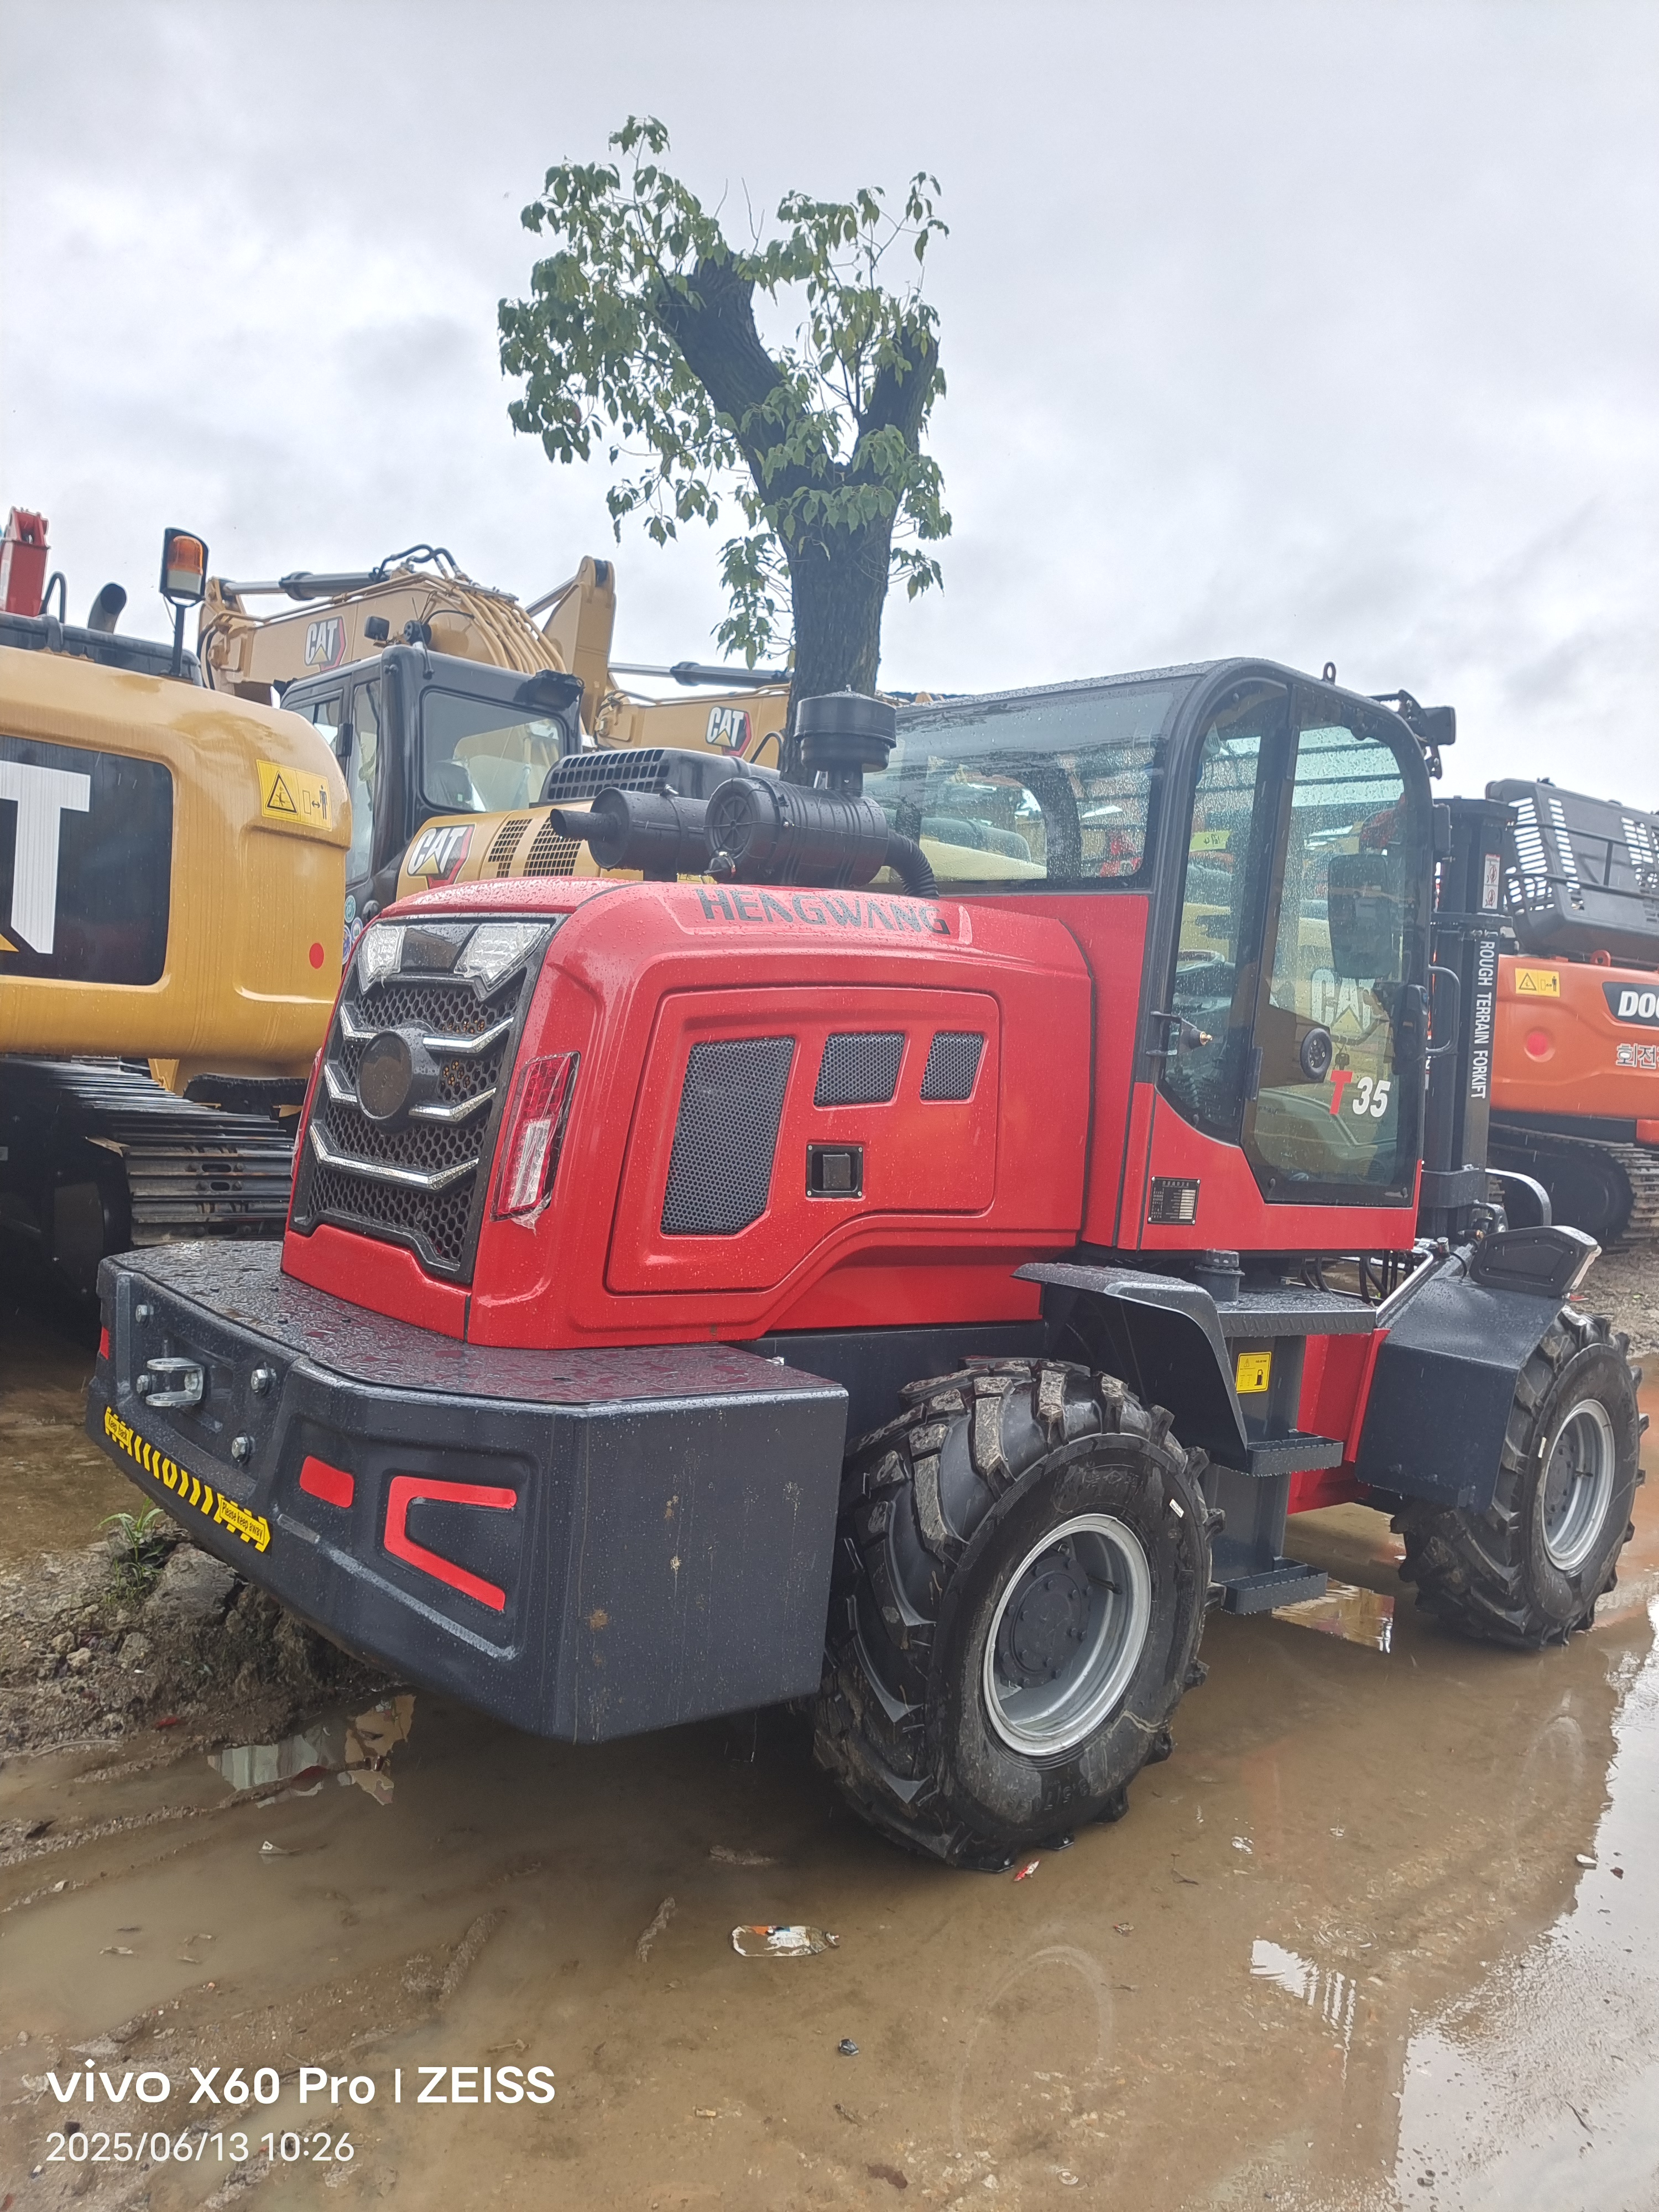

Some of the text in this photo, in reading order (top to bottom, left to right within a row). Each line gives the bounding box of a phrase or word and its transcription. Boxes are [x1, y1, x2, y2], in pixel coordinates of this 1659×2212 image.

[305, 618, 338, 665] CAT
[706, 707, 745, 747] CAT
[408, 826, 468, 874] CAT
[695, 888, 951, 935] HENGWANG
[1478, 940, 1495, 987] ROUGH
[1474, 992, 1492, 1044] TERRAIN
[1617, 990, 1659, 1019] DO
[1616, 1043, 1659, 1070] 회전
[222, 1501, 263, 1541] Please keep away
